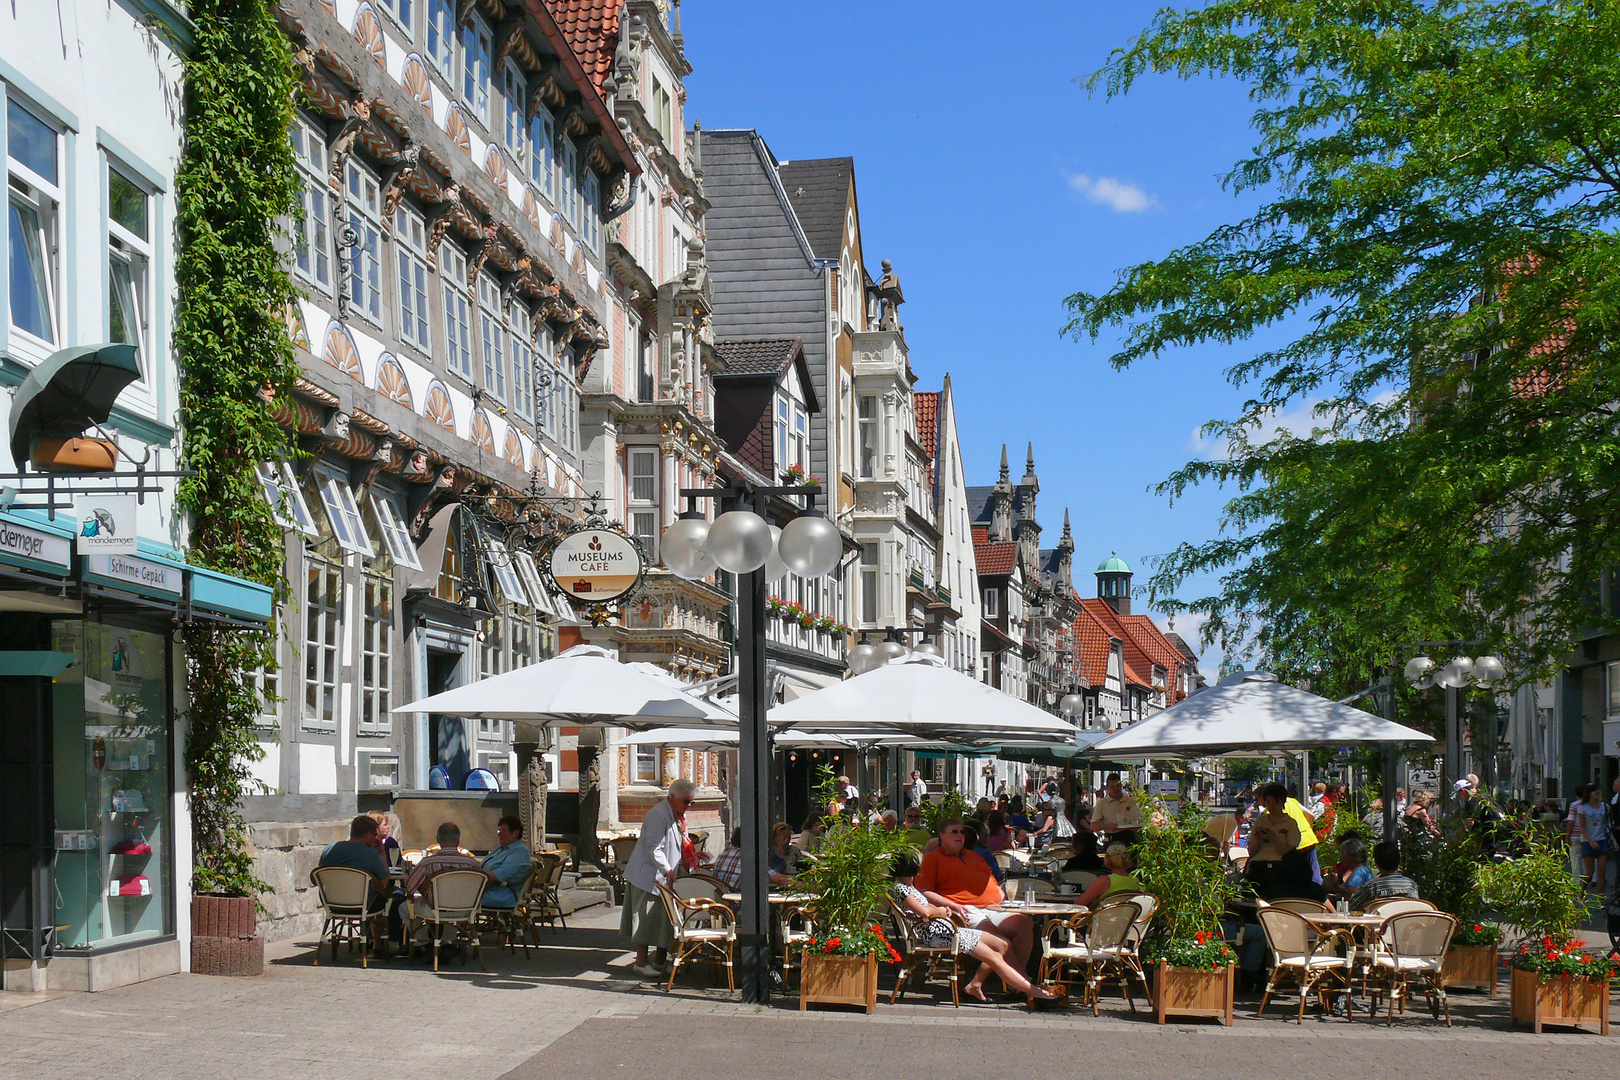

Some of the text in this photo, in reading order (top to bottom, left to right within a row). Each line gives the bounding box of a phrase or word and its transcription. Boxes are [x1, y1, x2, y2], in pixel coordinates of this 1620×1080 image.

[568, 552, 623, 562] MUSEUMS
[111, 558, 165, 585] Schirme Gepäck
